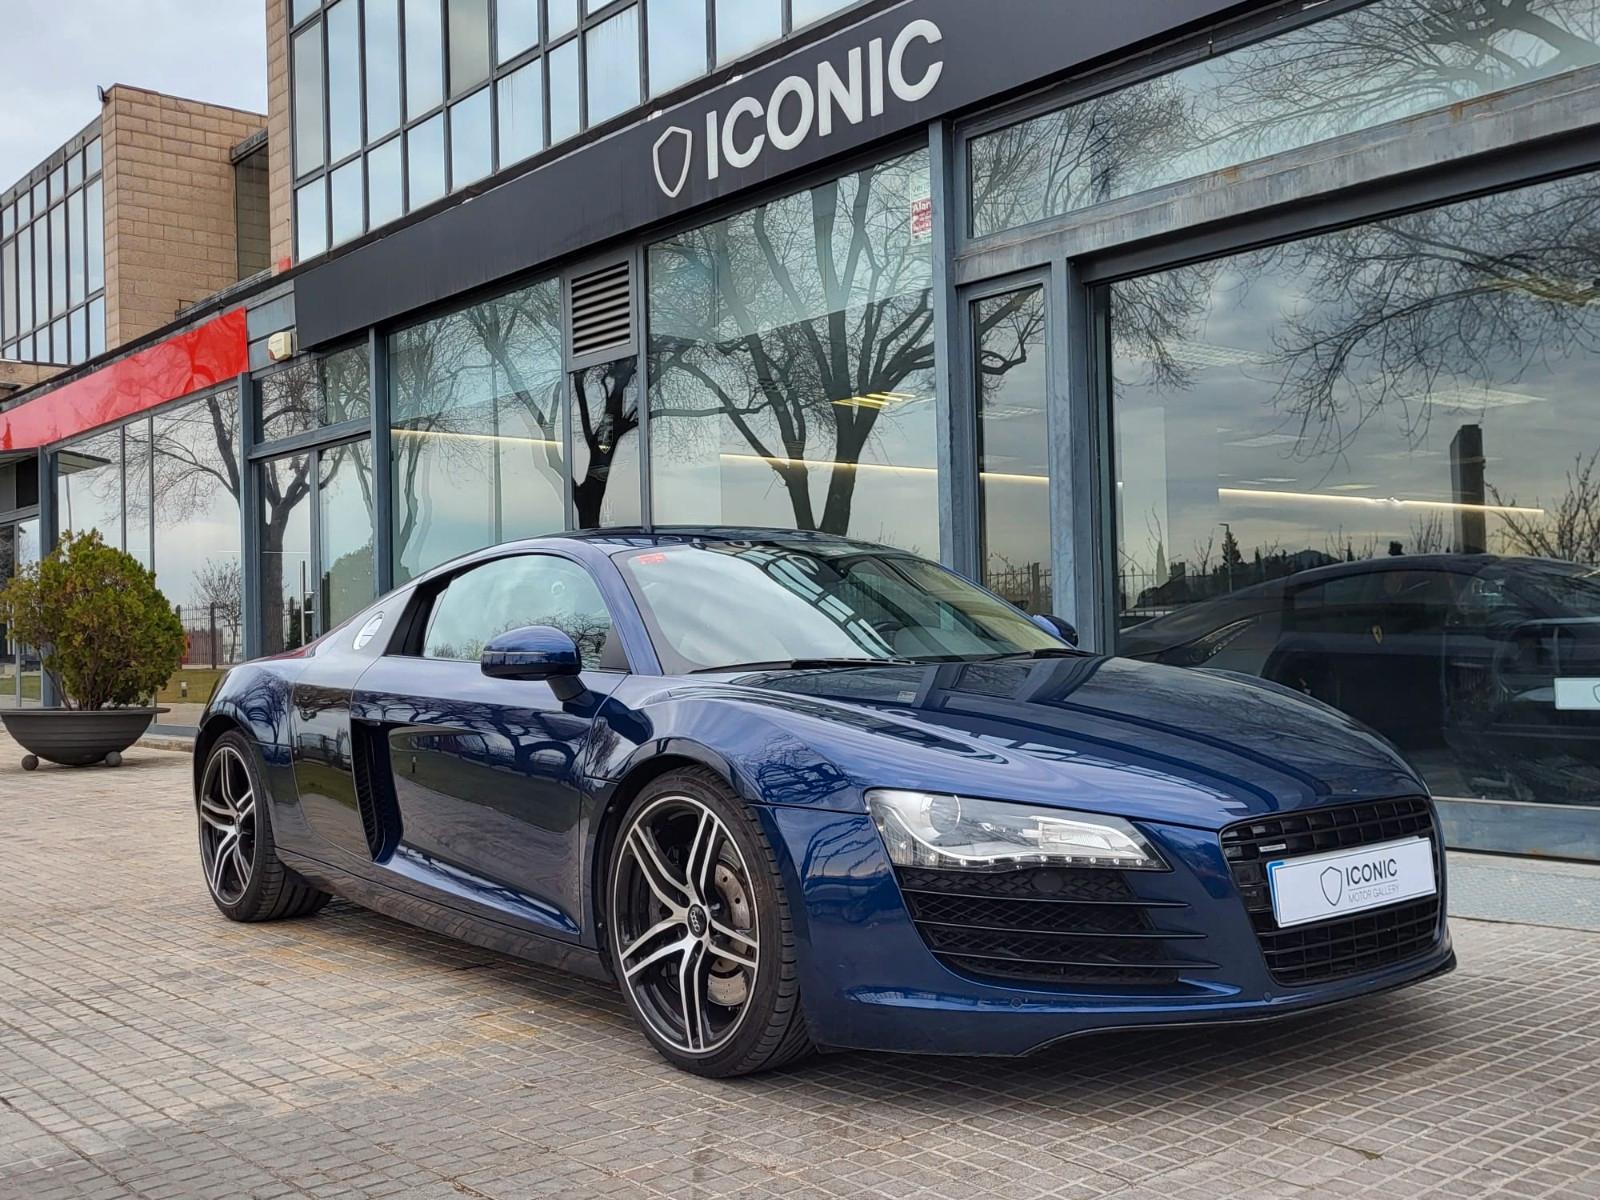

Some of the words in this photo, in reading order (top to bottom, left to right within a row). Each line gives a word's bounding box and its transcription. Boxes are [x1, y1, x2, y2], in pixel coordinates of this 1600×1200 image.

[706, 19, 943, 180] ICONIC
[1345, 858, 1397, 887] ICONIC
[1348, 888, 1372, 903] MOTOR
[1372, 884, 1399, 898] GALLERY
